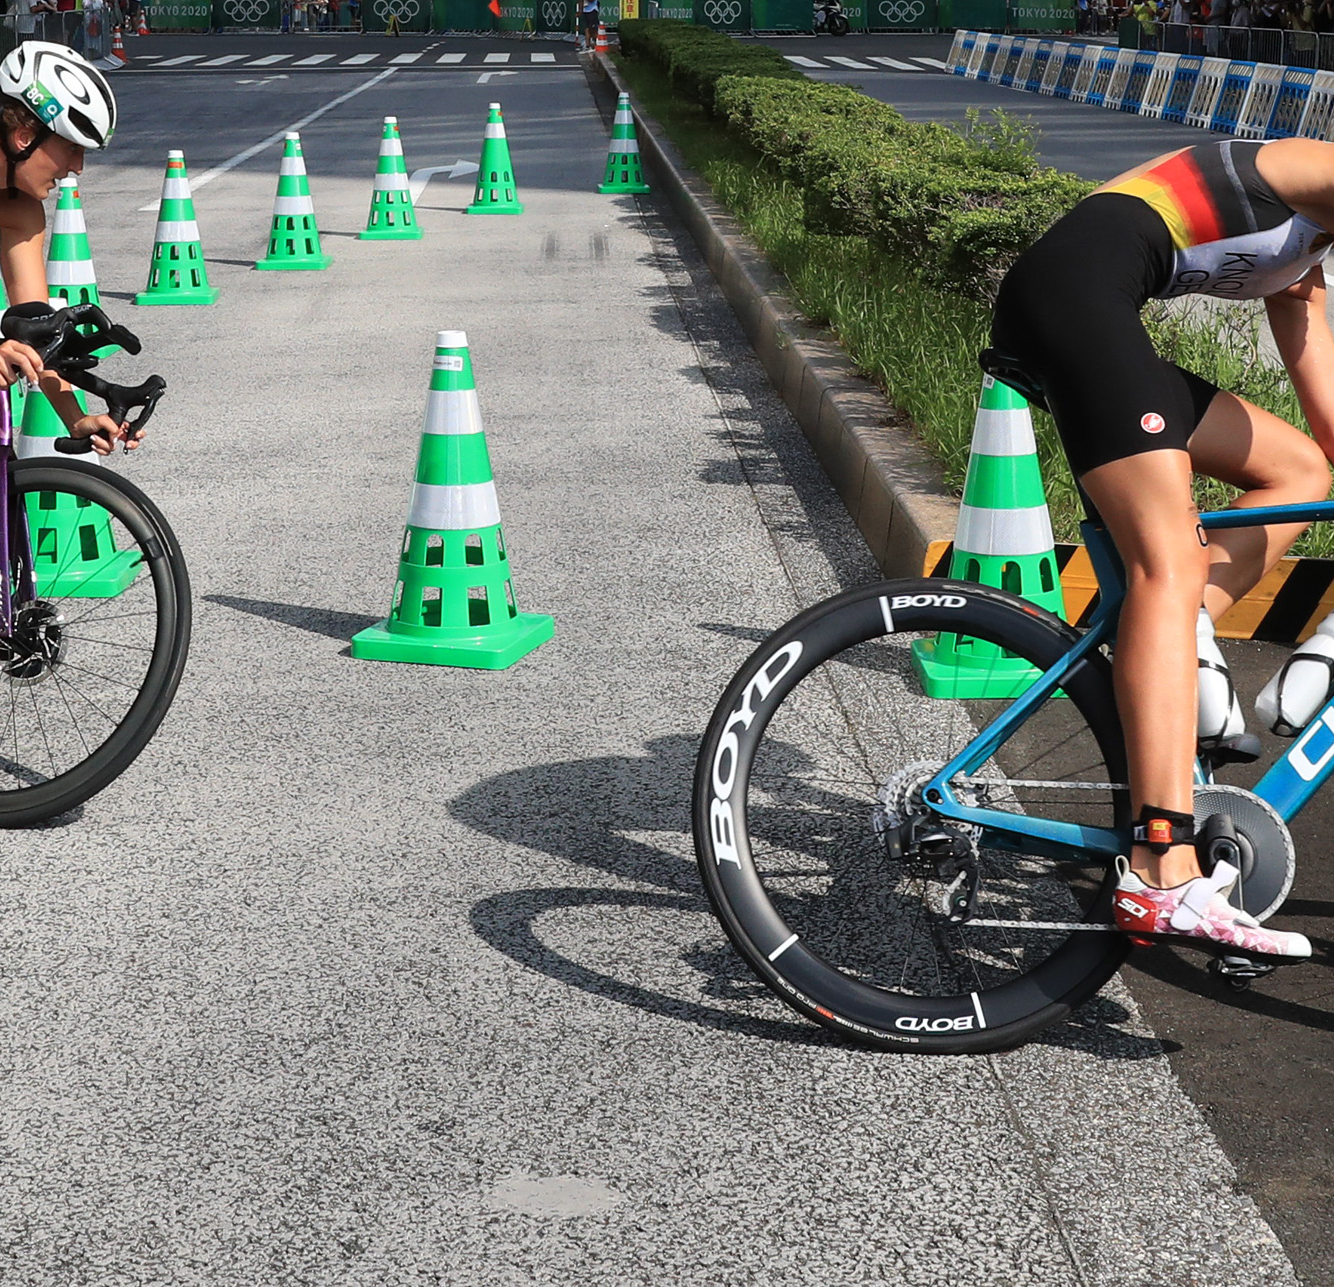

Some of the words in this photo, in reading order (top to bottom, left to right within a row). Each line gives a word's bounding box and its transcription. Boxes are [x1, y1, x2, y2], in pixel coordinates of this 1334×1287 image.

[144, 5, 180, 17] TOKYO
[181, 5, 208, 17] 2020
[499, 6, 517, 18] OKYO
[517, 7, 534, 19] 2020
[1011, 7, 1047, 18] TOKYO
[1048, 7, 1076, 20] 2020
[26, 86, 45, 106] 8C
[889, 593, 967, 611] BOYD
[709, 639, 804, 870] BOYD
[893, 1013, 975, 1033] BOYD
